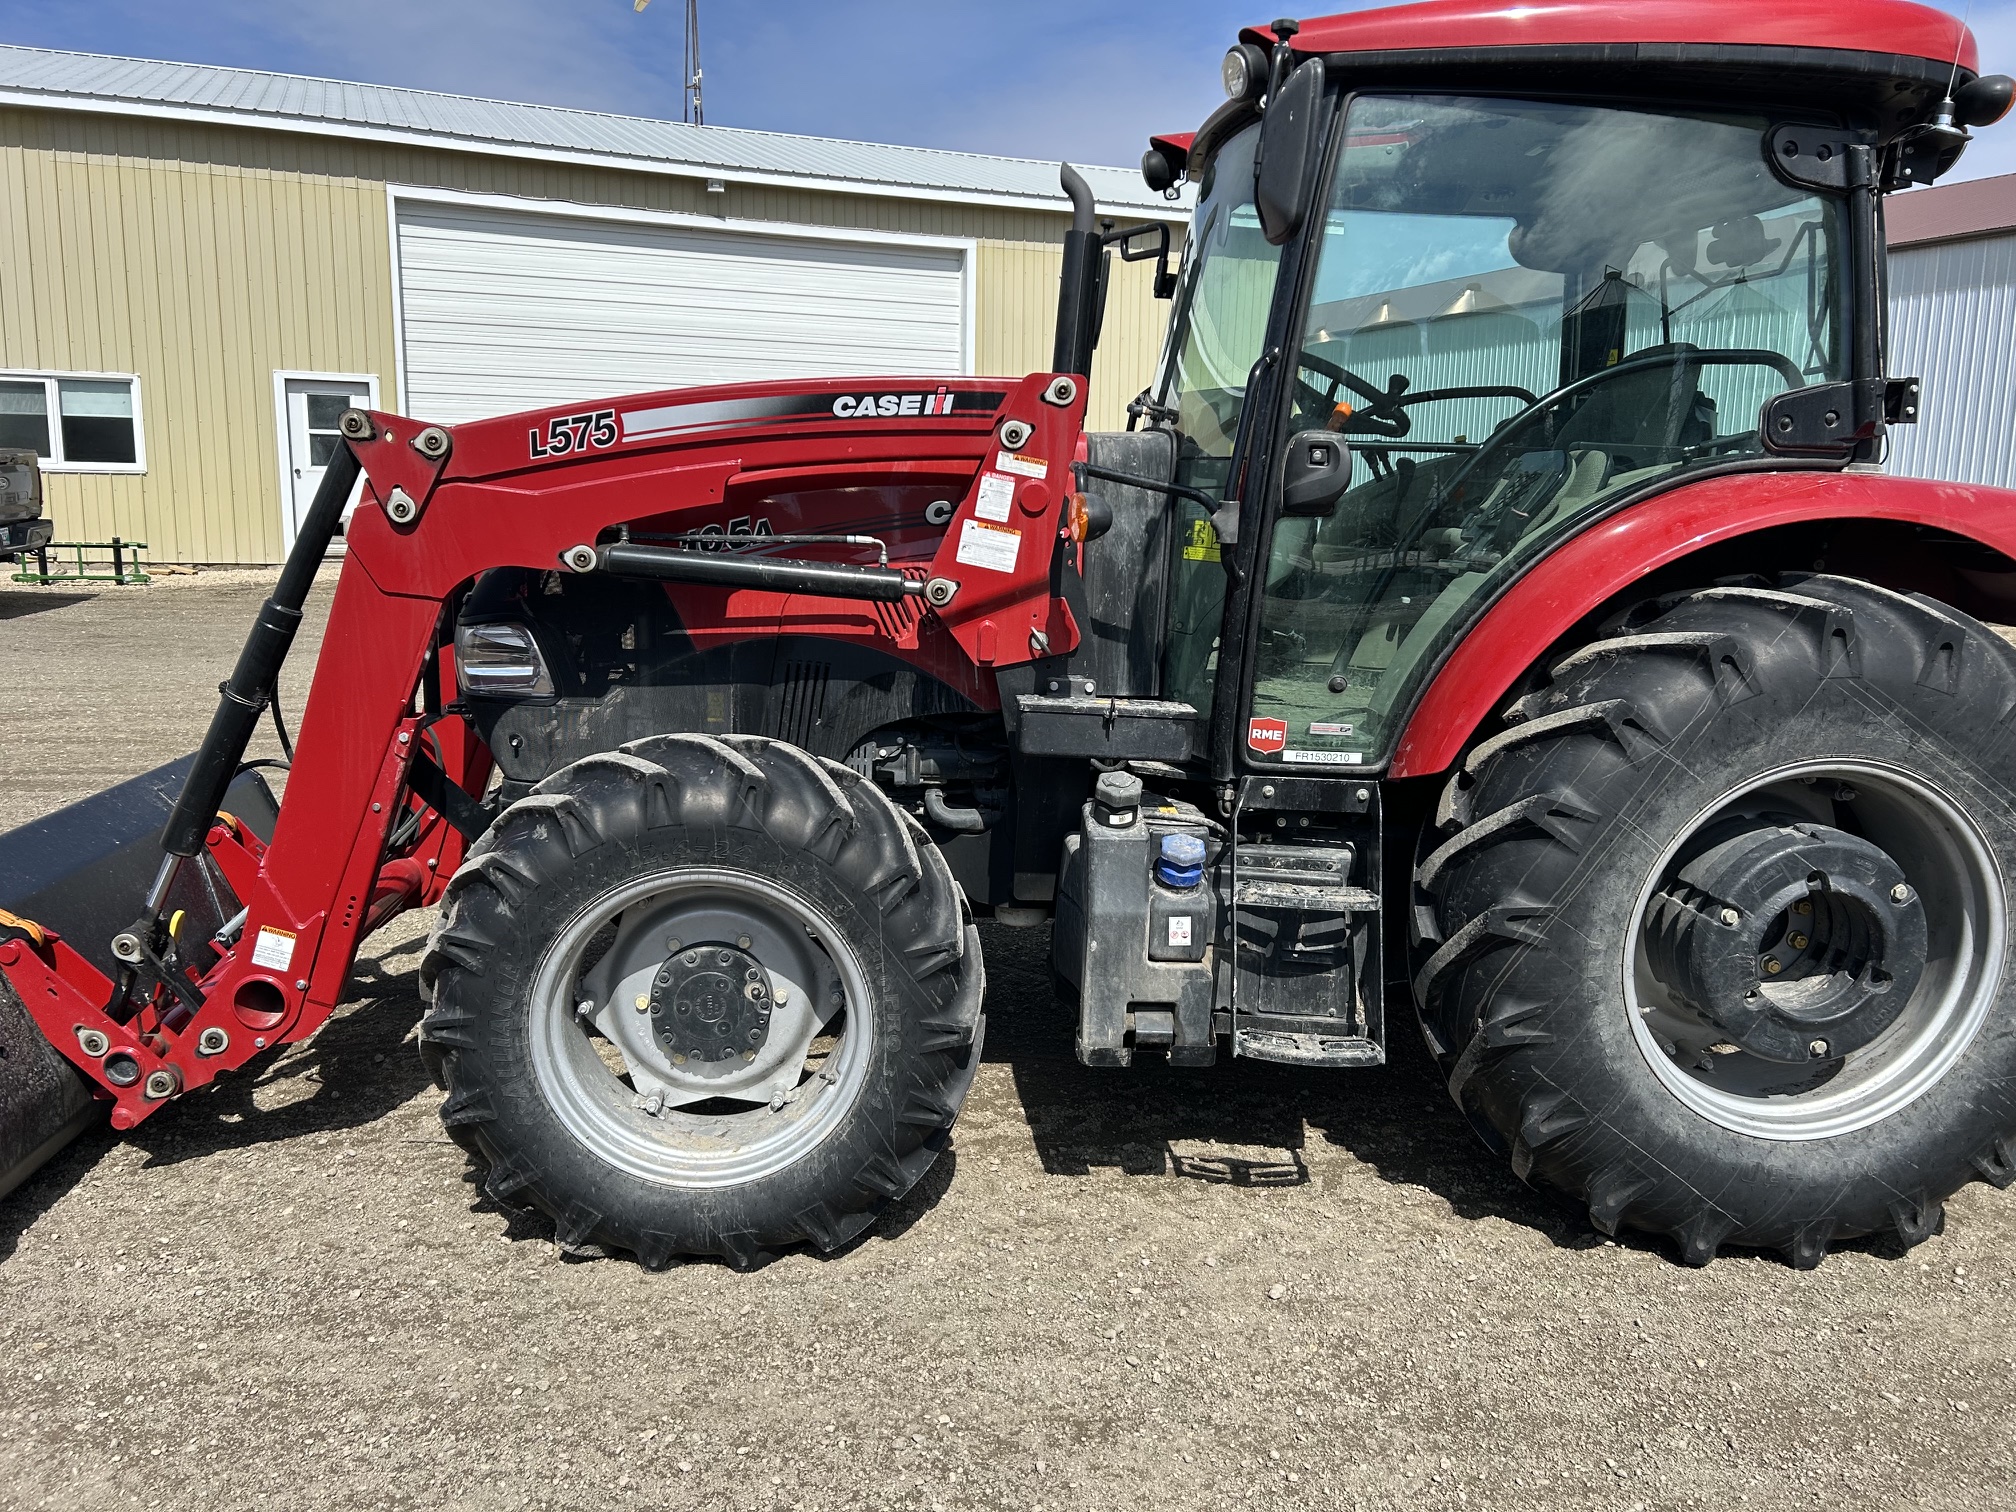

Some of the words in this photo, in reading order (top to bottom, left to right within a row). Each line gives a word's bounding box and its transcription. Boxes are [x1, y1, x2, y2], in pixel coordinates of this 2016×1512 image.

[833, 395, 922, 417] CASE
[528, 408, 618, 460] L575
[991, 472, 1015, 482] DANGER
[1251, 728, 1282, 740] RME
[1295, 752, 1349, 762] FR1530210
[268, 927, 295, 939] WARNING
[490, 962, 531, 1098] ALLIANCE
